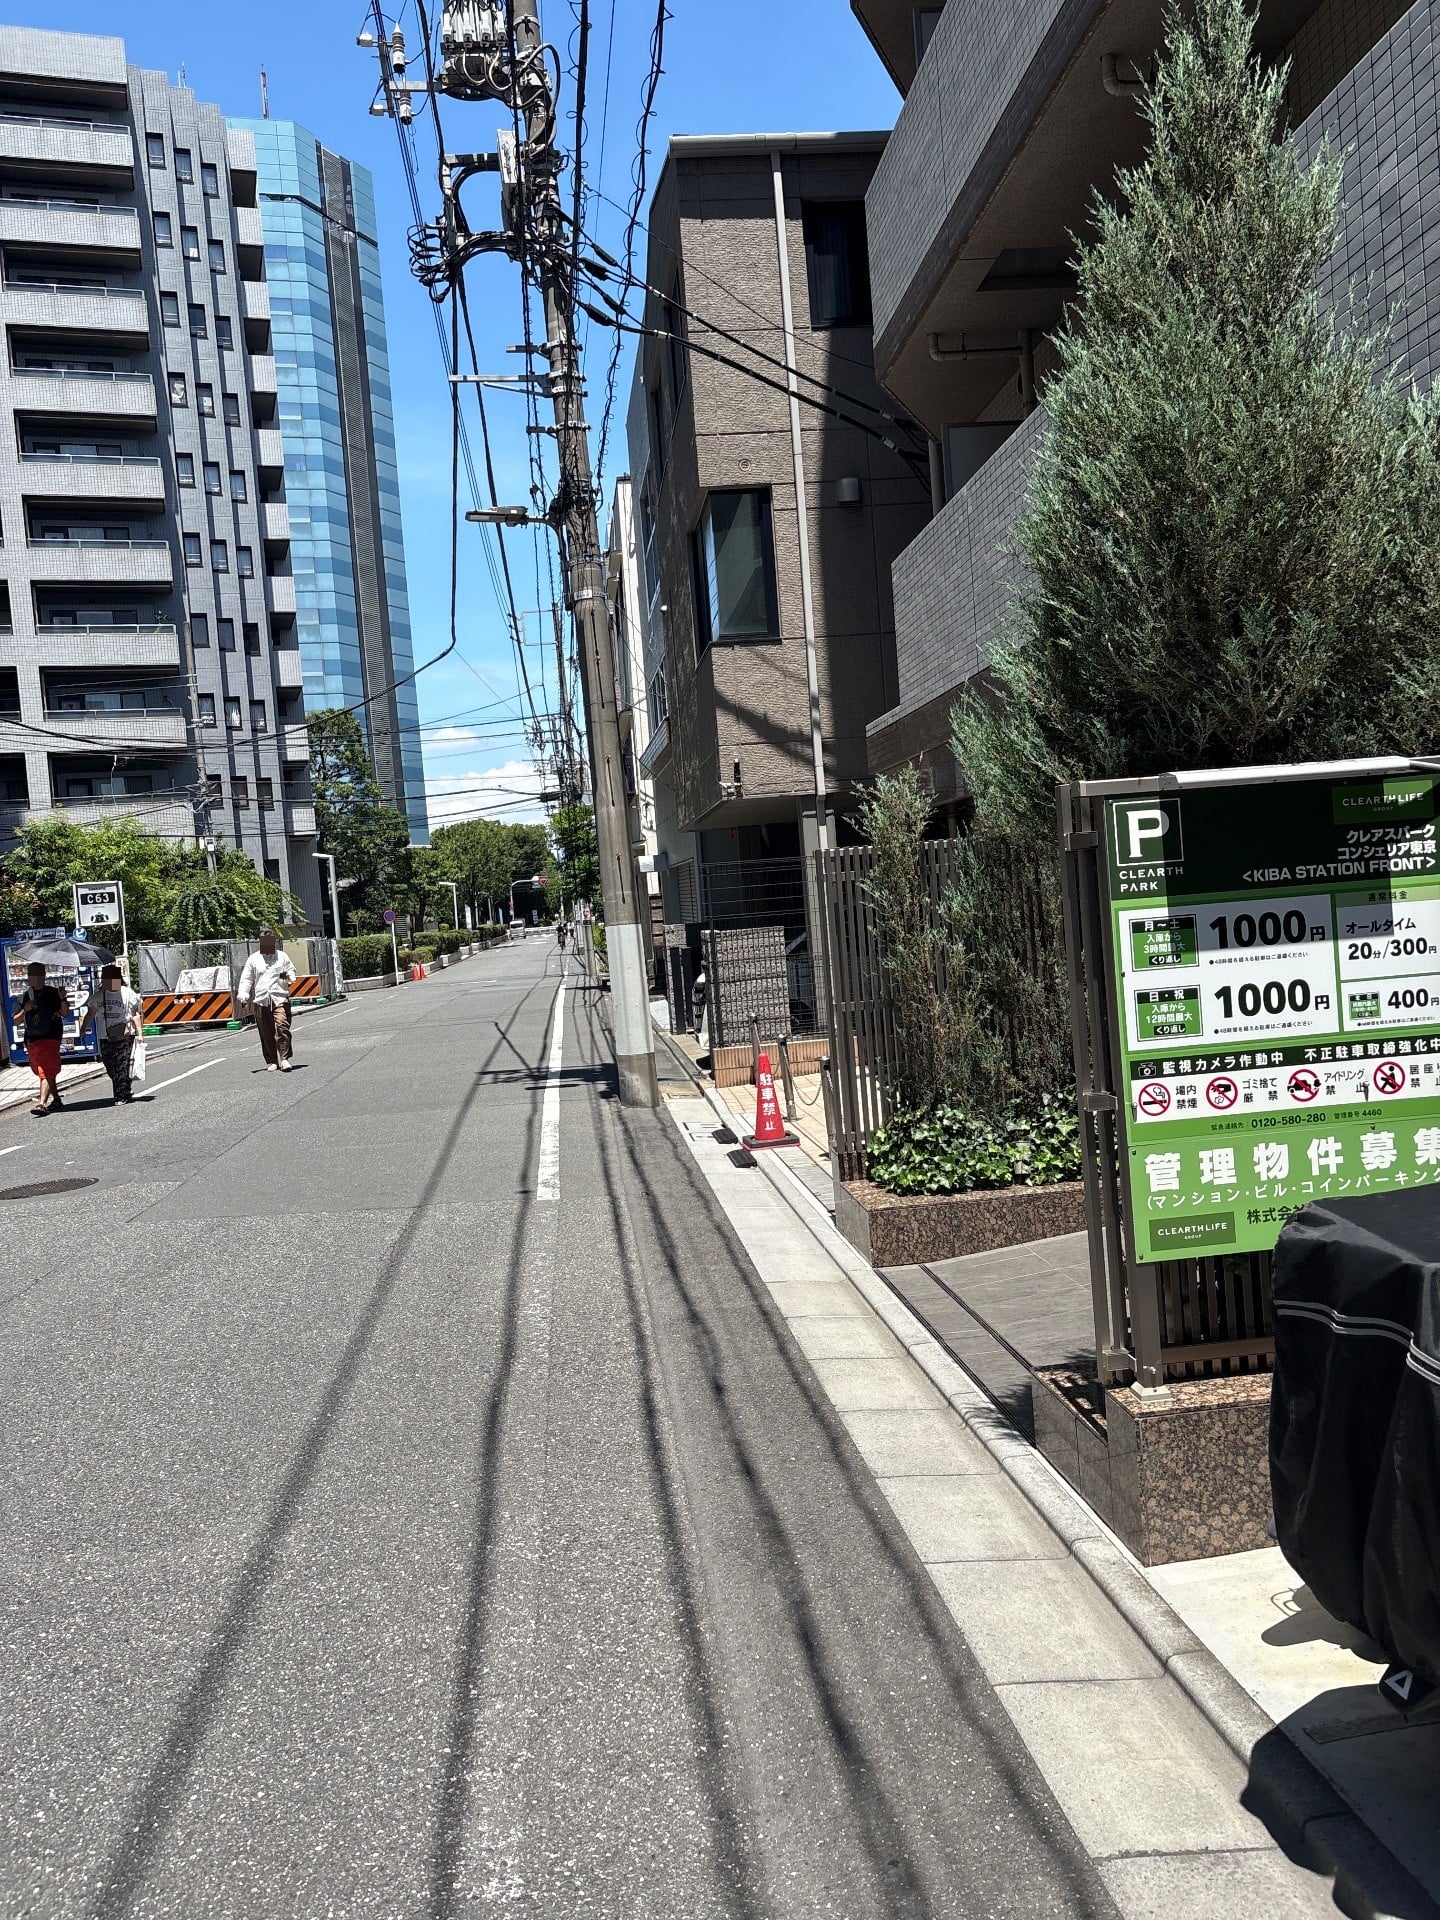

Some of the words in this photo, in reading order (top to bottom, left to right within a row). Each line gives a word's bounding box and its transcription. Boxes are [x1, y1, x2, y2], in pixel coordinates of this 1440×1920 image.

[1126, 809, 1170, 858] P
[1346, 823, 1436, 845] クレアスパーク
[1337, 839, 1437, 860] コンシェリア東京
[1119, 866, 1184, 880] CLEARTH
[1295, 861, 1365, 880] STATION
[1120, 881, 1159, 893] PARK
[1345, 917, 1417, 935] オールタイム
[1146, 931, 1181, 943] 入庫から
[1143, 942, 1186, 954] 3時間最大
[1151, 954, 1181, 964] くり返し
[1151, 1004, 1186, 1014] 入庫から
[1145, 1012, 1193, 1024] 12時間最大
[1156, 1023, 1186, 1034] くり返し
[1162, 1051, 1284, 1075] 監視カメラ作動中
[1304, 1037, 1440, 1061] 不正駐車取締強化中
[1324, 1068, 1366, 1083] アイドリング
[1242, 1077, 1278, 1090] ゴミ捨て
[759, 1073, 778, 1131] 駐車禁止
[1176, 1097, 1198, 1110] 禁煙
[1251, 1112, 1326, 1129] 0120-580-280
[1362, 1108, 1382, 1117] 4460
[1144, 1126, 1440, 1193] 管理物件募集
